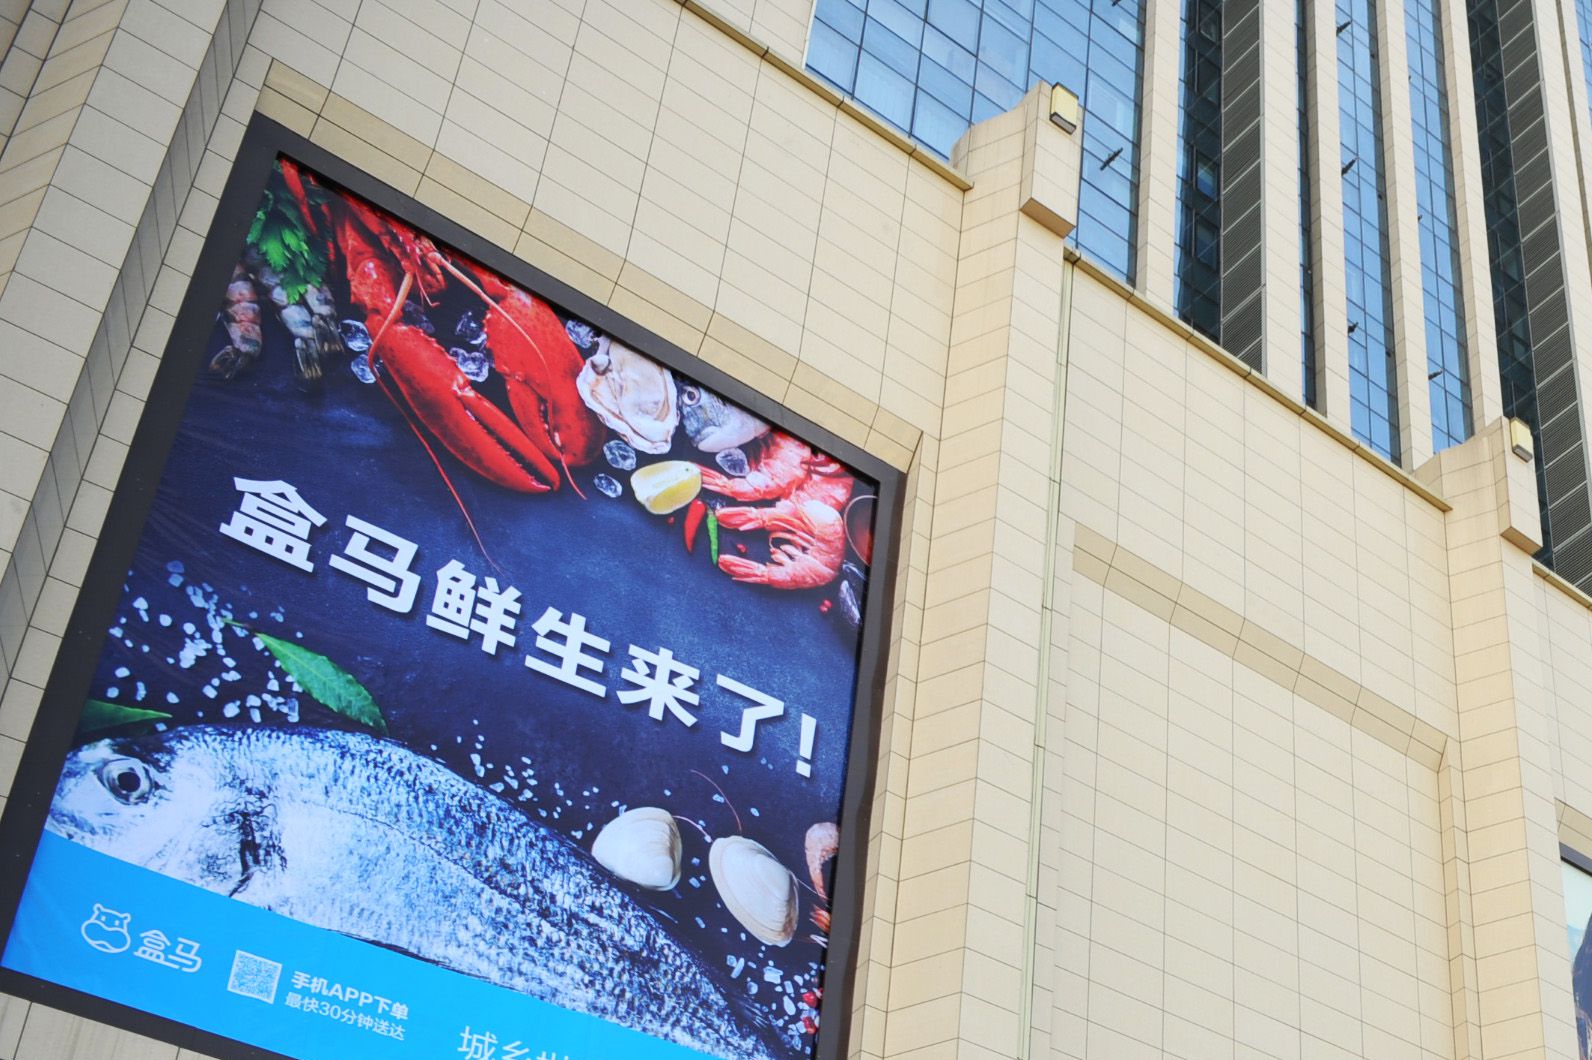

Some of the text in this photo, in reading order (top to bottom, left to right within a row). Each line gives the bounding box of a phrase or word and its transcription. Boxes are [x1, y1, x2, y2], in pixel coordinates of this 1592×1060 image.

[133, 929, 202, 973] 盒马
[285, 991, 406, 1041] 最快30分钟送达
[291, 970, 409, 1021] 手机APP下单
